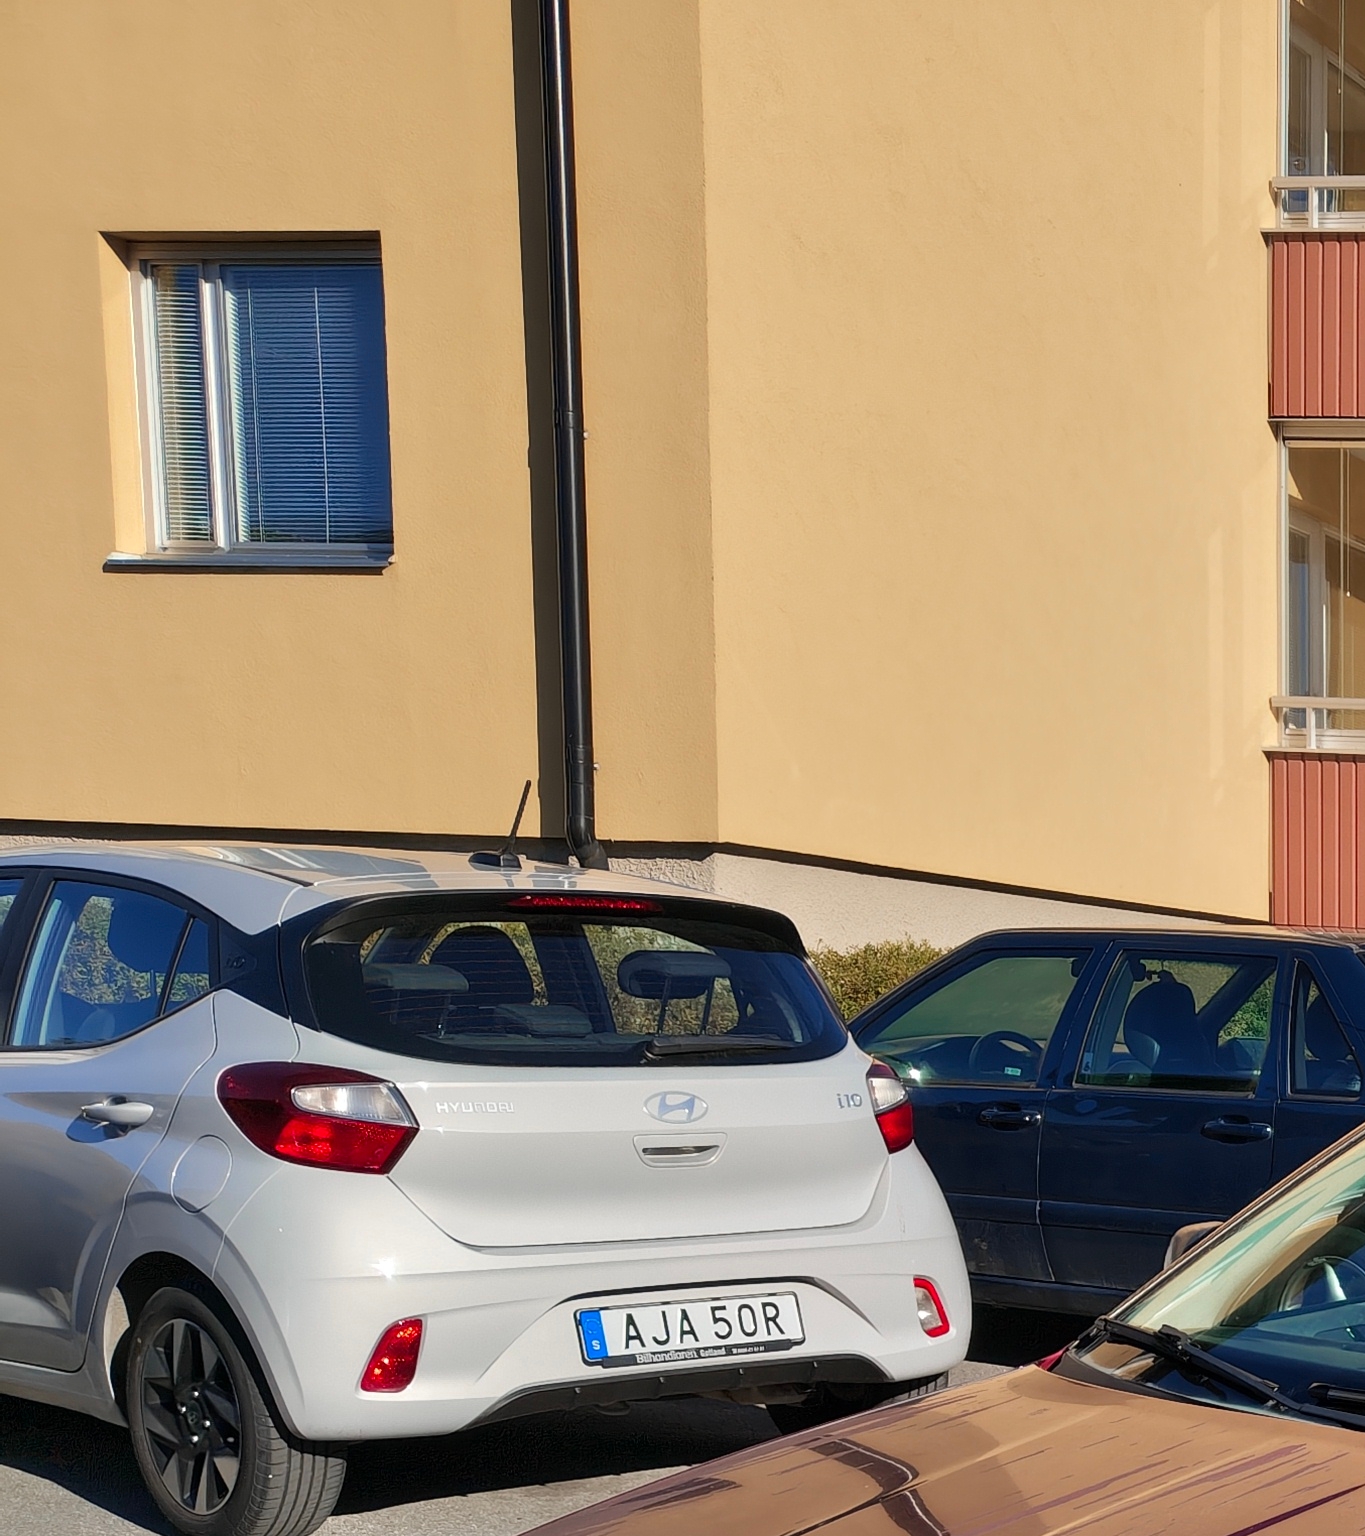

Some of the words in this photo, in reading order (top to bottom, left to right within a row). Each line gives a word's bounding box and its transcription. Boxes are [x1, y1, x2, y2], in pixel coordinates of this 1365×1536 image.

[436, 1102, 515, 1114] HYUNDAI
[836, 1093, 862, 1109] i10
[624, 1308, 700, 1350] AJA
[710, 1301, 786, 1340] 50R
[591, 1340, 601, 1350] S
